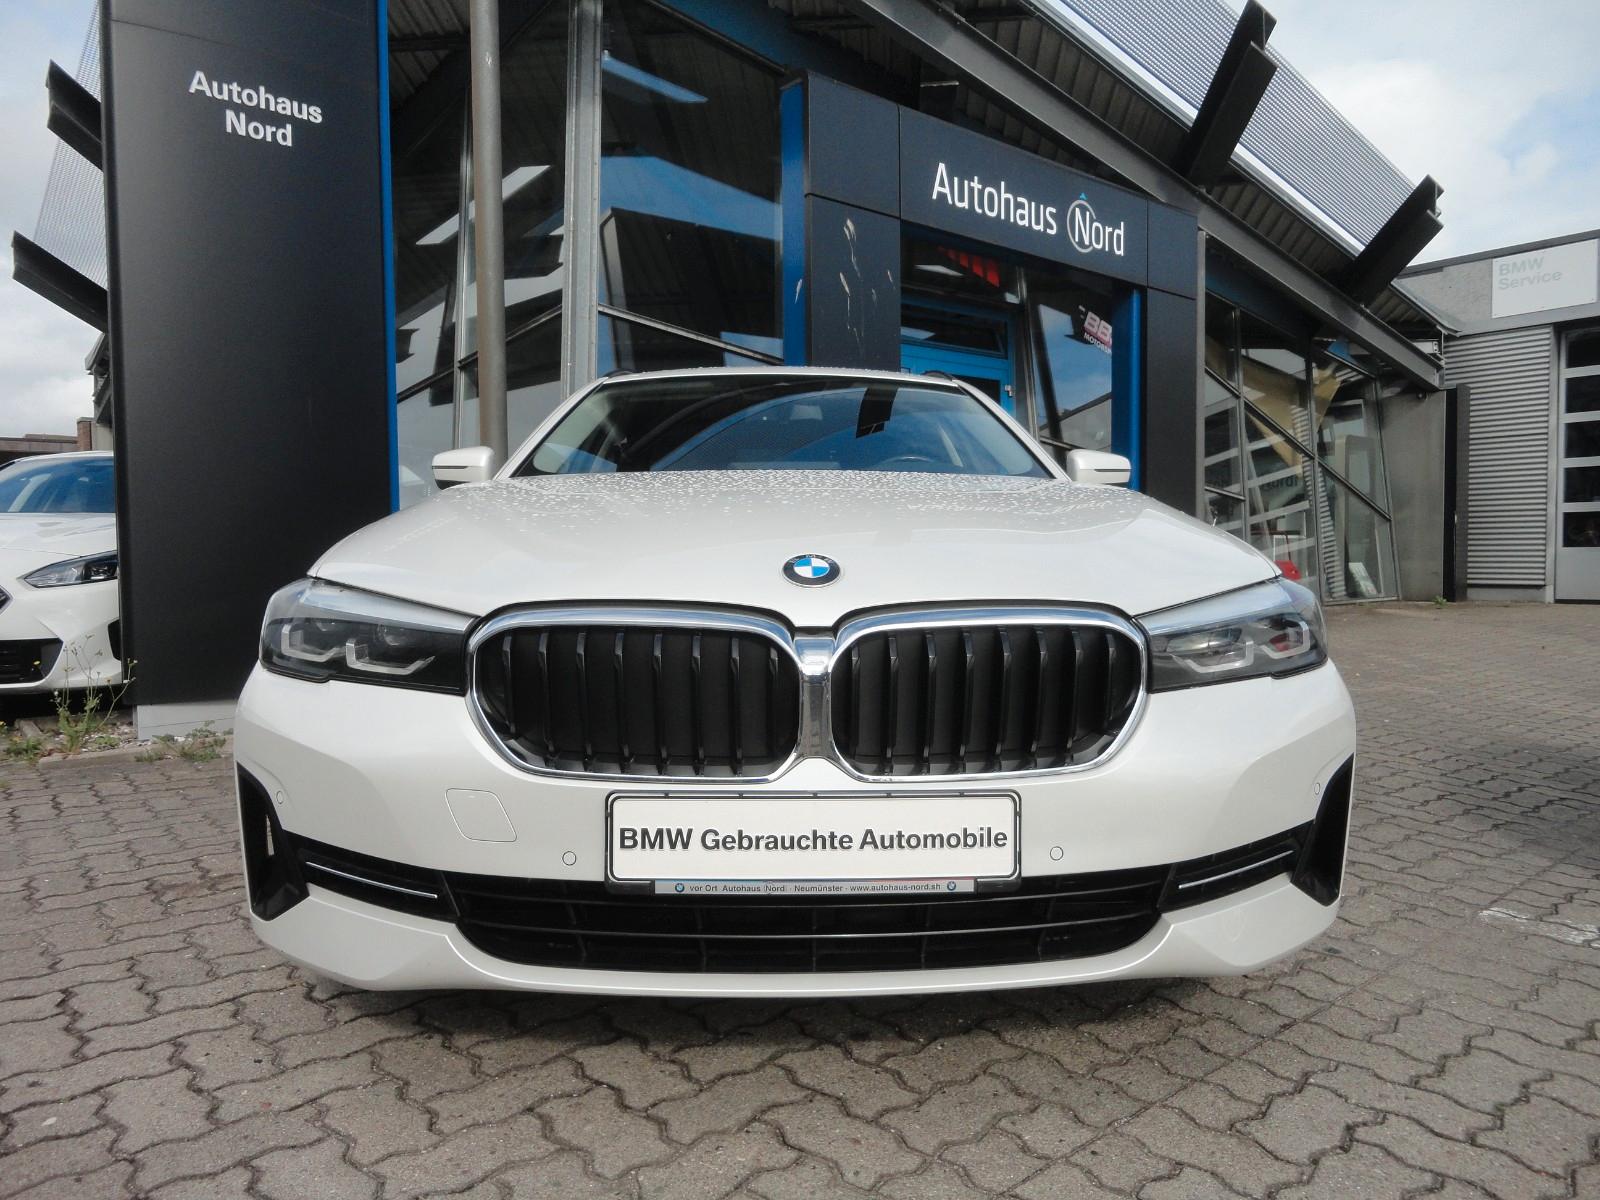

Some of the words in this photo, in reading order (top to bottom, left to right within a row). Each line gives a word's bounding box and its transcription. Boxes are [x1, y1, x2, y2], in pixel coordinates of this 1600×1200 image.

[188, 70, 323, 124] Autohaus
[225, 109, 293, 147] Nord
[932, 162, 1057, 235] Autohaus
[1074, 207, 1125, 257] Nord
[1498, 271, 1563, 290] Service
[1499, 256, 1545, 276] BMW
[1084, 311, 1112, 347] BB
[619, 827, 694, 850] BMW
[700, 828, 853, 850] Gebrauchte
[859, 826, 1008, 850] Automobile
[705, 884, 718, 892] Ort
[721, 884, 761, 892] Autohaus
[765, 884, 785, 892] Nord
[794, 883, 844, 892] Neumünster
[850, 882, 941, 892] www.autohaus-nord.sh
